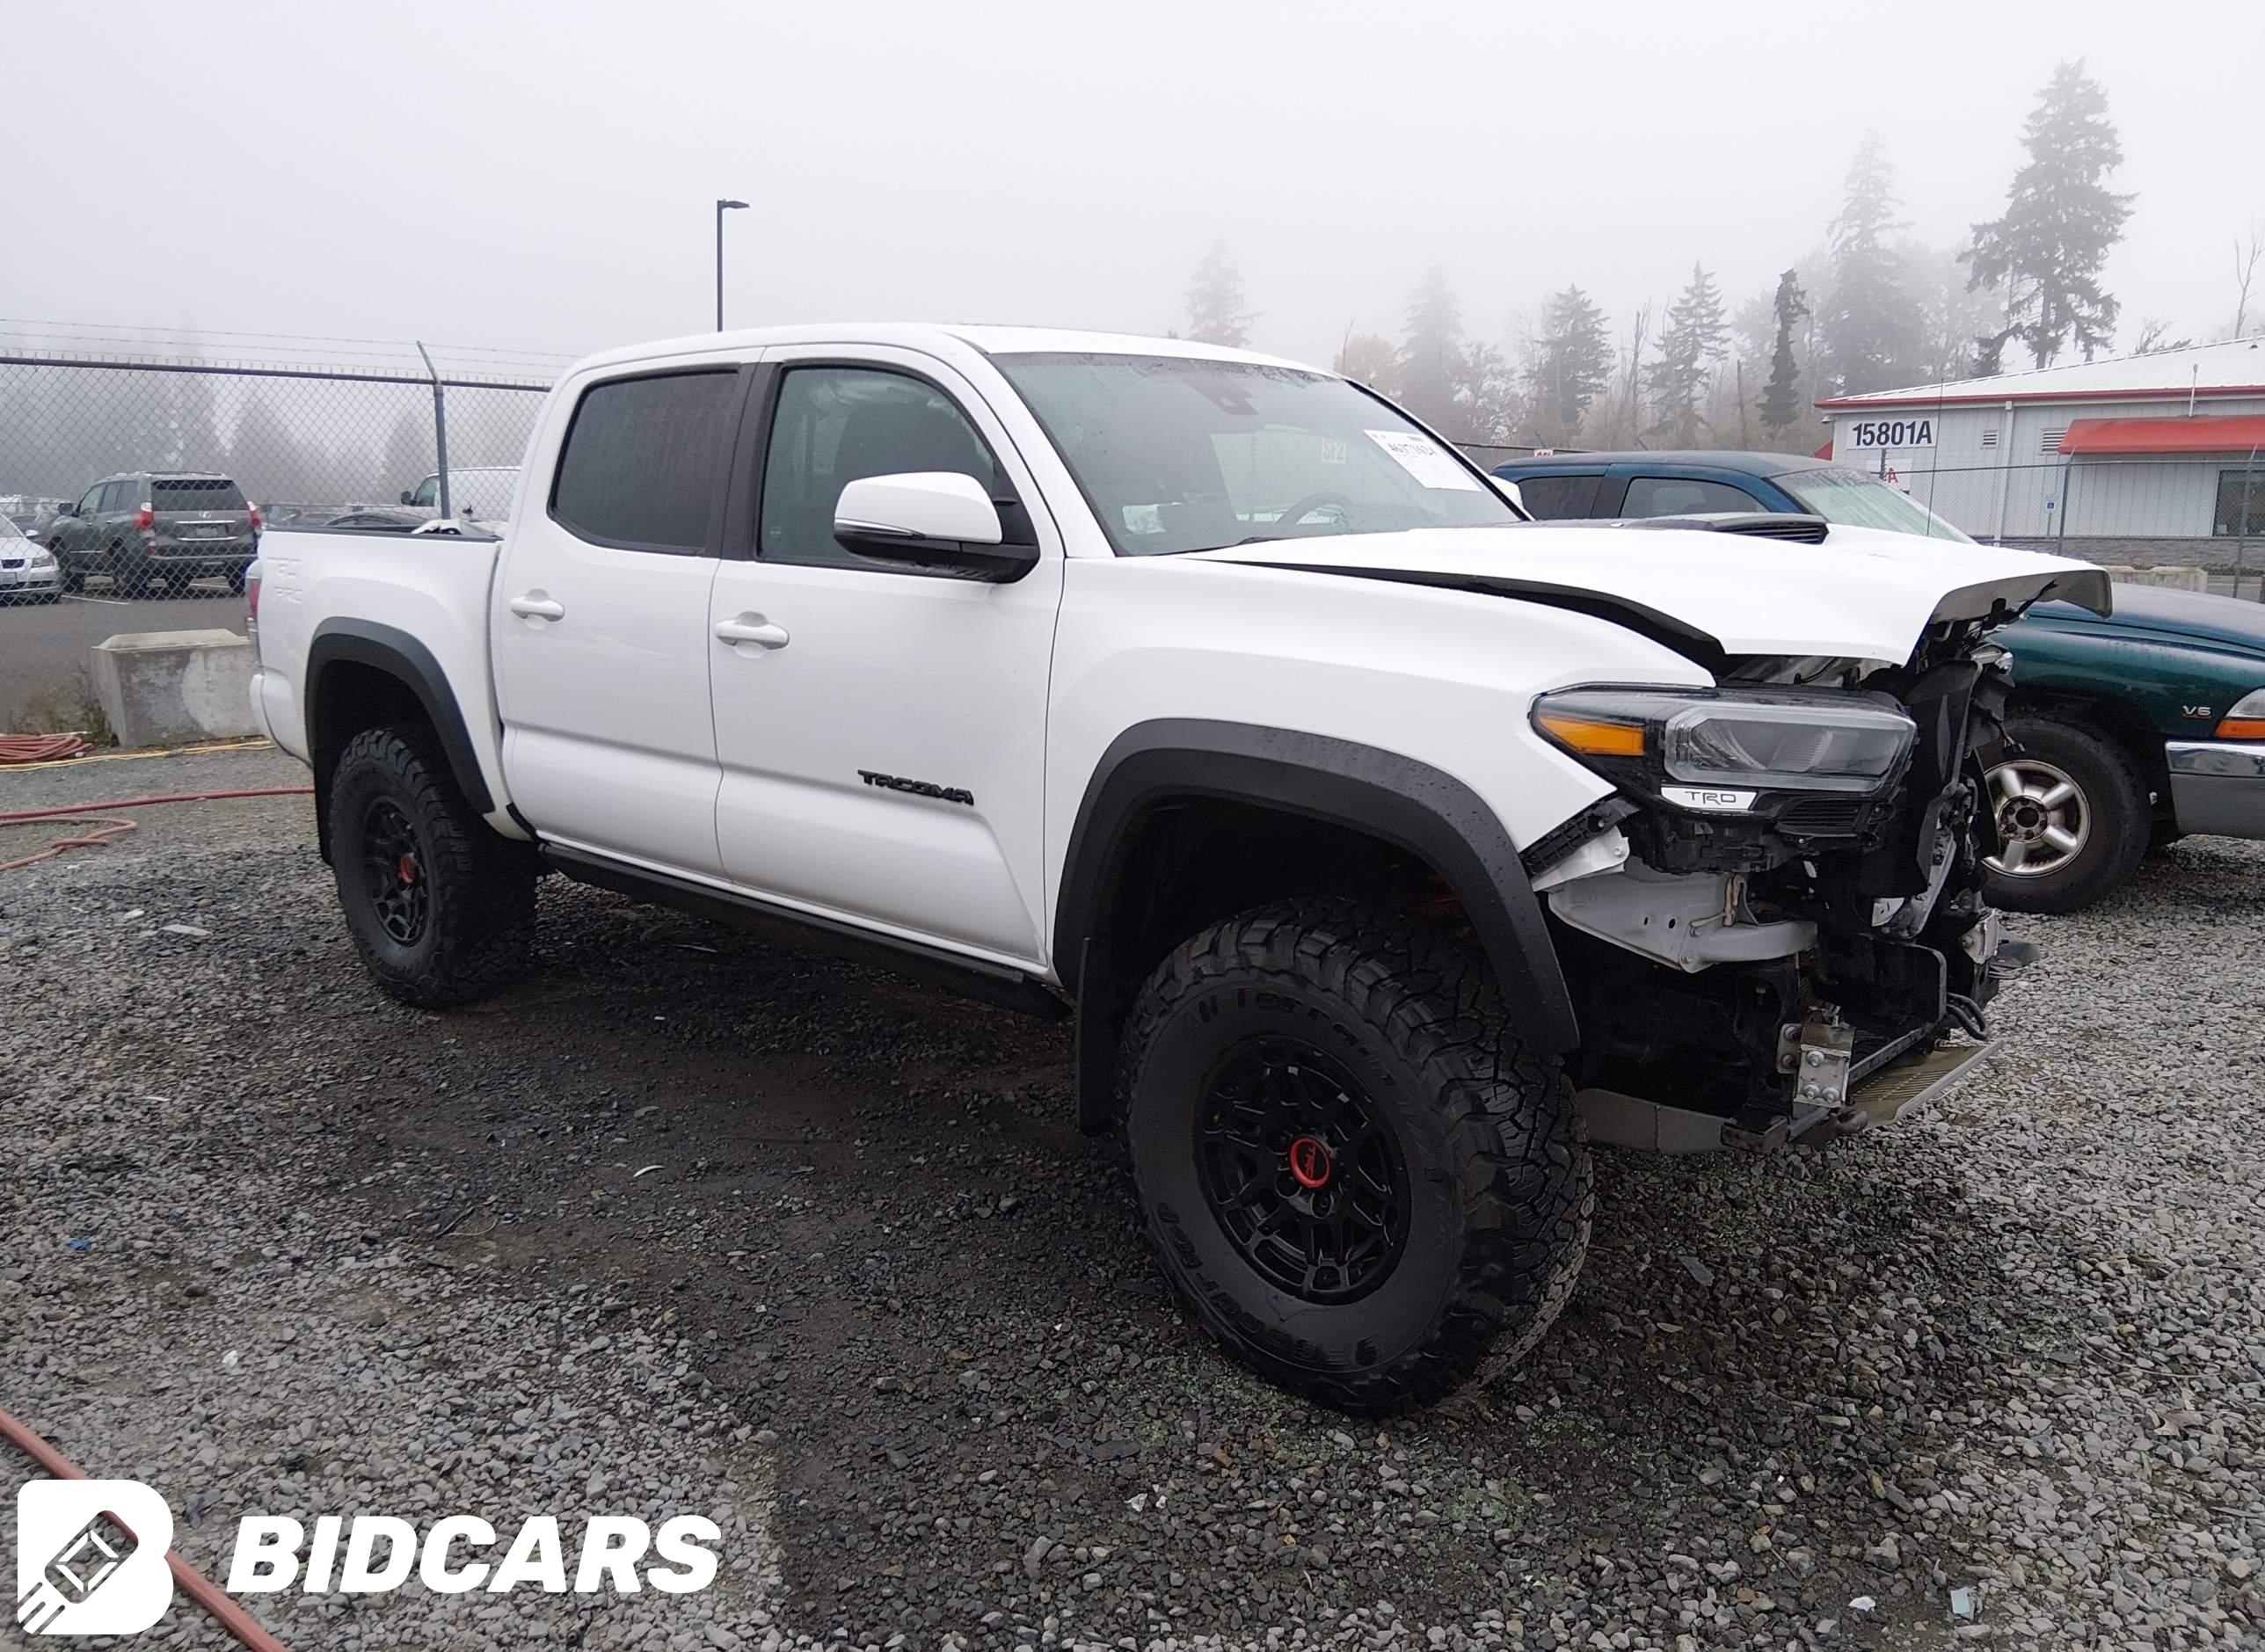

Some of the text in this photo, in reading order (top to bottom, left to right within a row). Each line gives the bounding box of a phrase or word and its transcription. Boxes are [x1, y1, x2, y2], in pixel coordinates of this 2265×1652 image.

[1853, 420, 1932, 446] 15801A
[2182, 706, 2210, 716] V6
[857, 769, 974, 806] TACOMA
[1685, 791, 1737, 805] TRD
